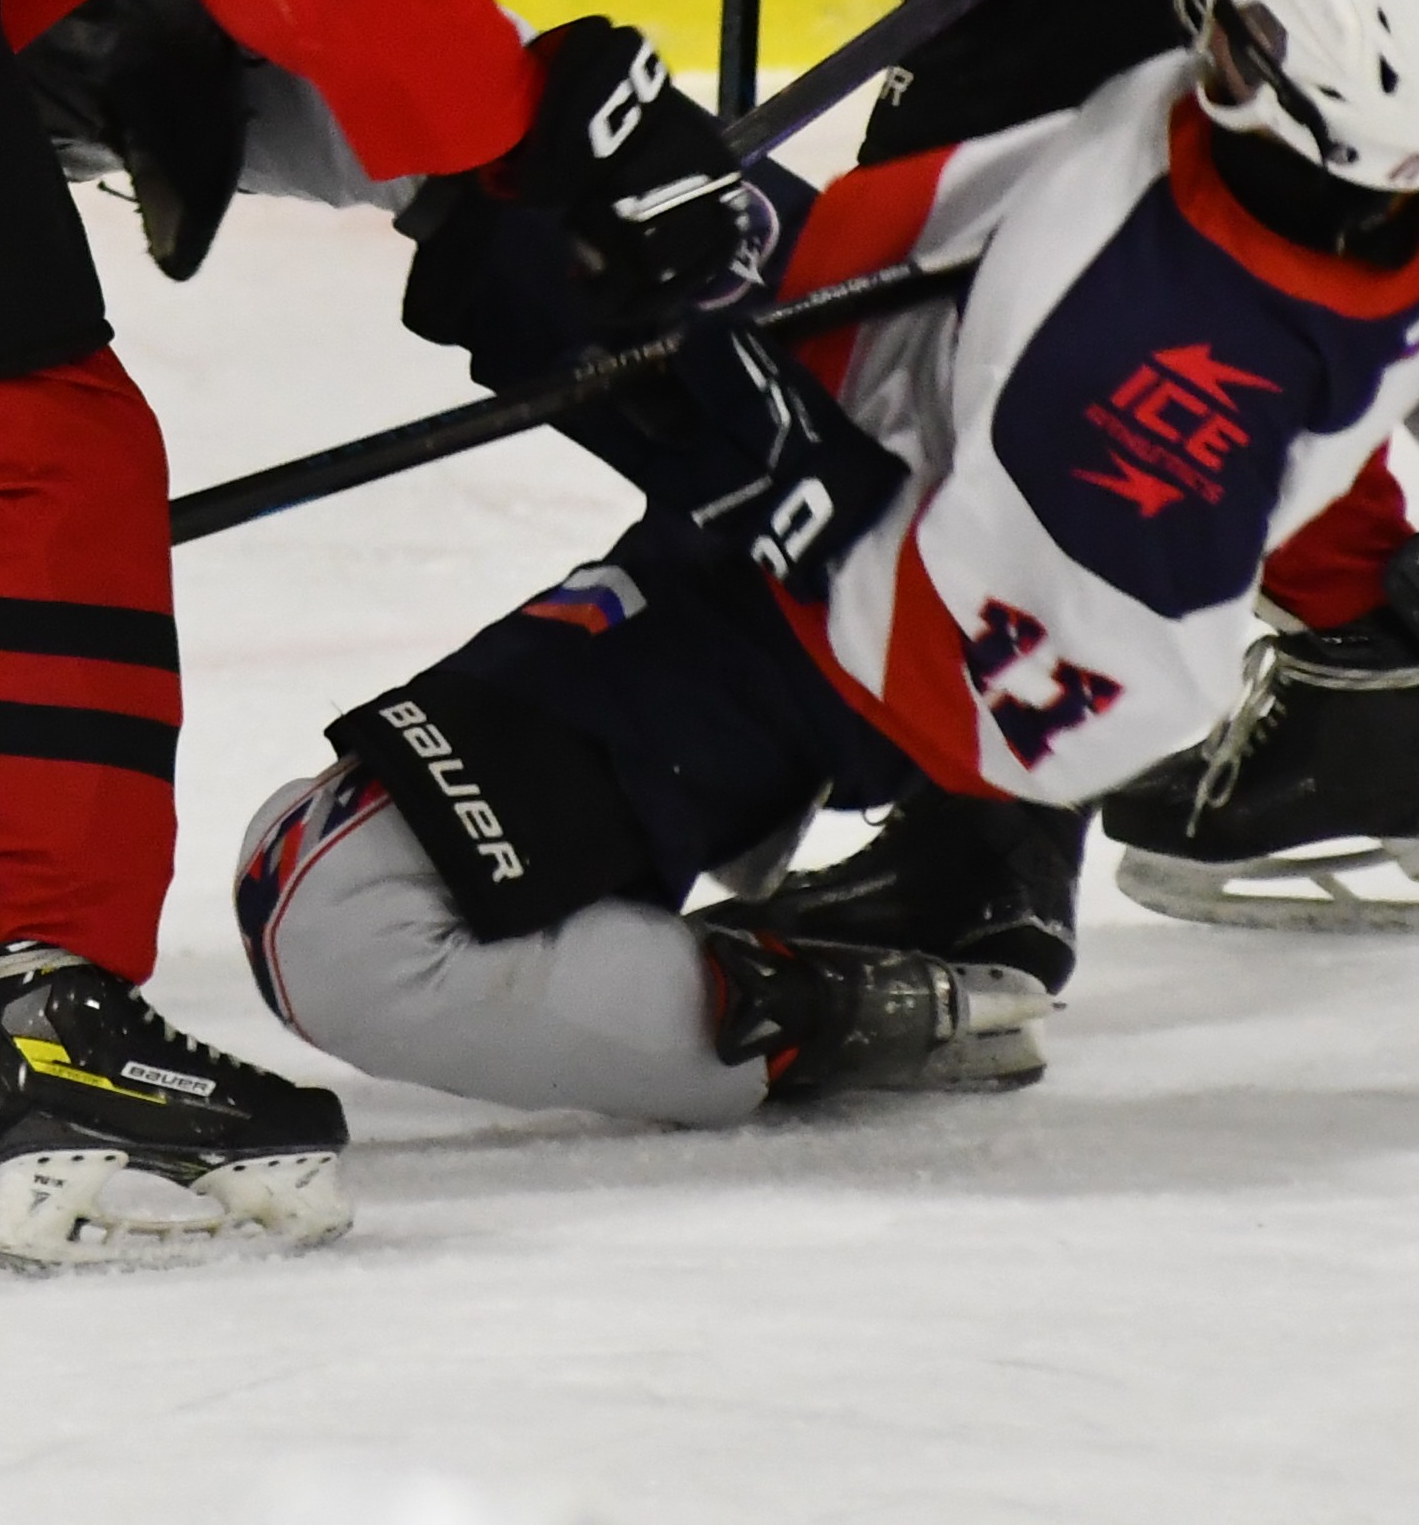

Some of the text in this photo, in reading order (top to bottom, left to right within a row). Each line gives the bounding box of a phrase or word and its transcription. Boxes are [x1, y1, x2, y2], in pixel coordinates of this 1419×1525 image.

[1111, 365, 1251, 471] ICE
[379, 700, 524, 883] BAUER
[130, 1065, 210, 1093] BAUER
